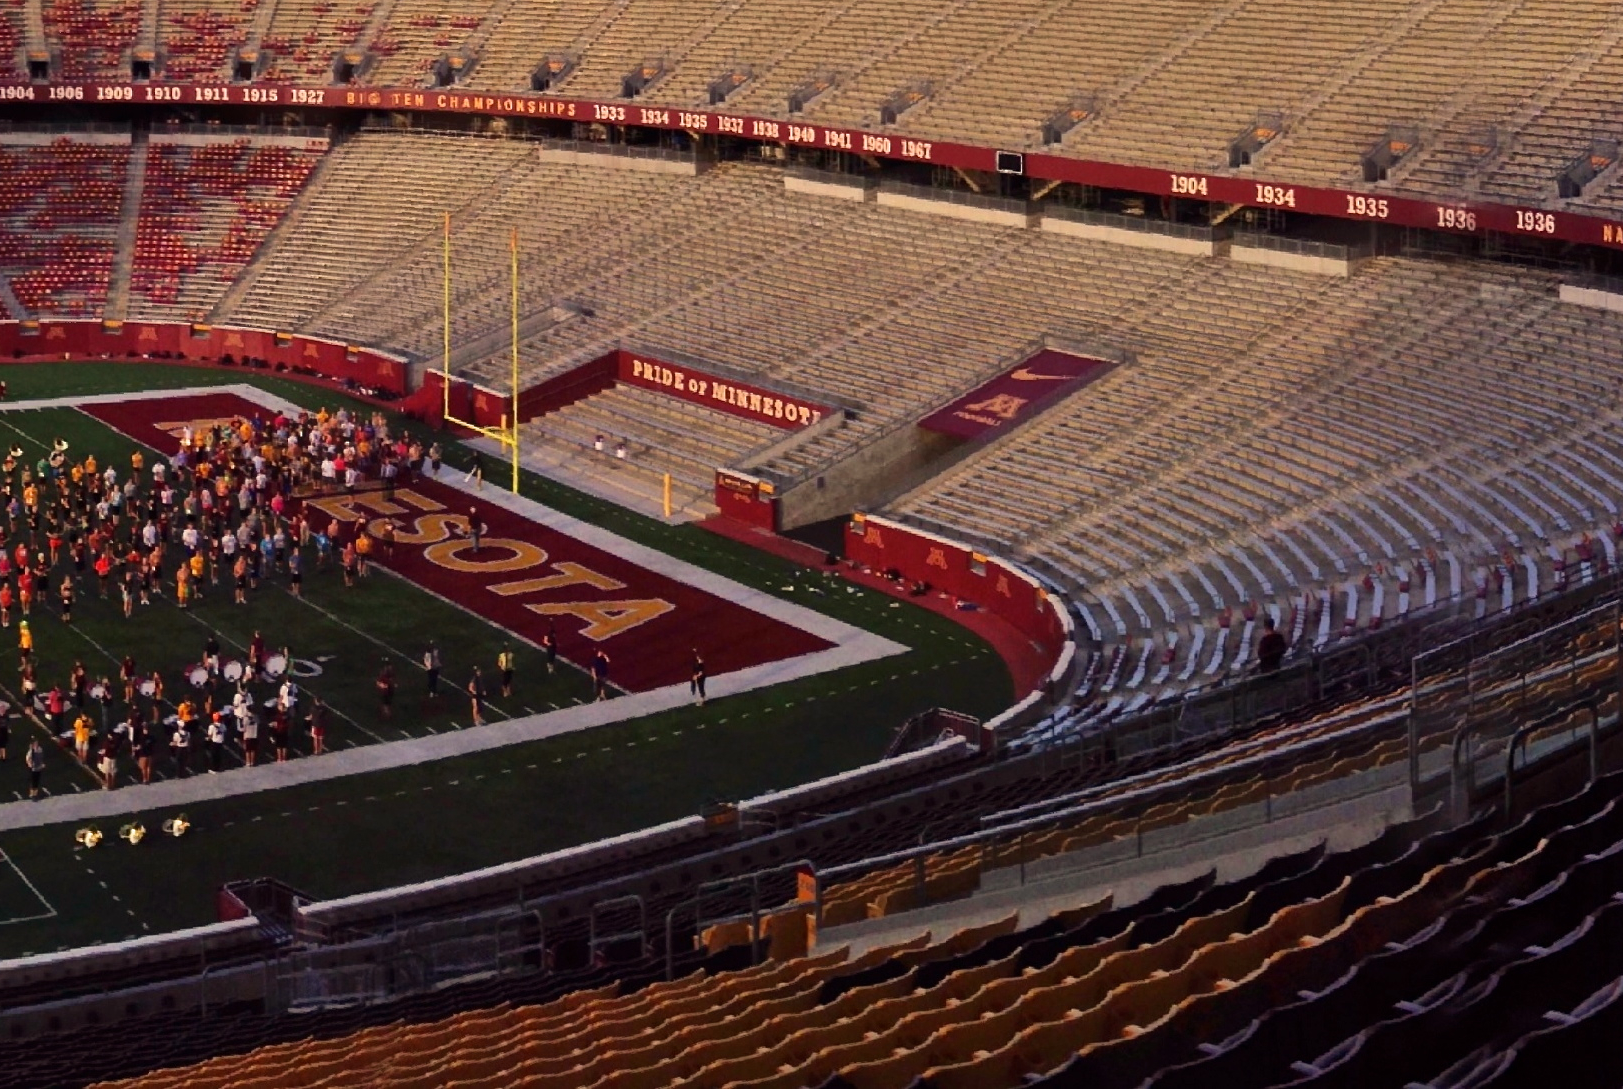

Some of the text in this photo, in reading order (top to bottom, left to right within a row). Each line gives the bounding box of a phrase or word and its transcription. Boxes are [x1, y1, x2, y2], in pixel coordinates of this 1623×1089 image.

[0, 86, 35, 100] 1904
[49, 86, 83, 100] 1906
[96, 86, 133, 100] 1909
[145, 87, 181, 100] 1910
[195, 87, 230, 101] 1911
[243, 88, 278, 102] 1915
[291, 89, 325, 104] 1927
[392, 93, 425, 107] TEN
[437, 95, 576, 117] CHAMPIONSHIPS
[593, 104, 626, 121] 1933
[640, 109, 669, 125] 1934
[788, 125, 815, 142] 1940
[825, 130, 851, 149] 1941
[863, 135, 891, 154] 1960
[901, 140, 932, 159] 1967
[1171, 174, 1208, 195] 1904
[1255, 185, 1295, 207] 1934
[1346, 195, 1389, 219] 1935
[1437, 207, 1477, 231] 1936
[1516, 210, 1556, 234] 1936
[633, 360, 685, 391] PRIDE
